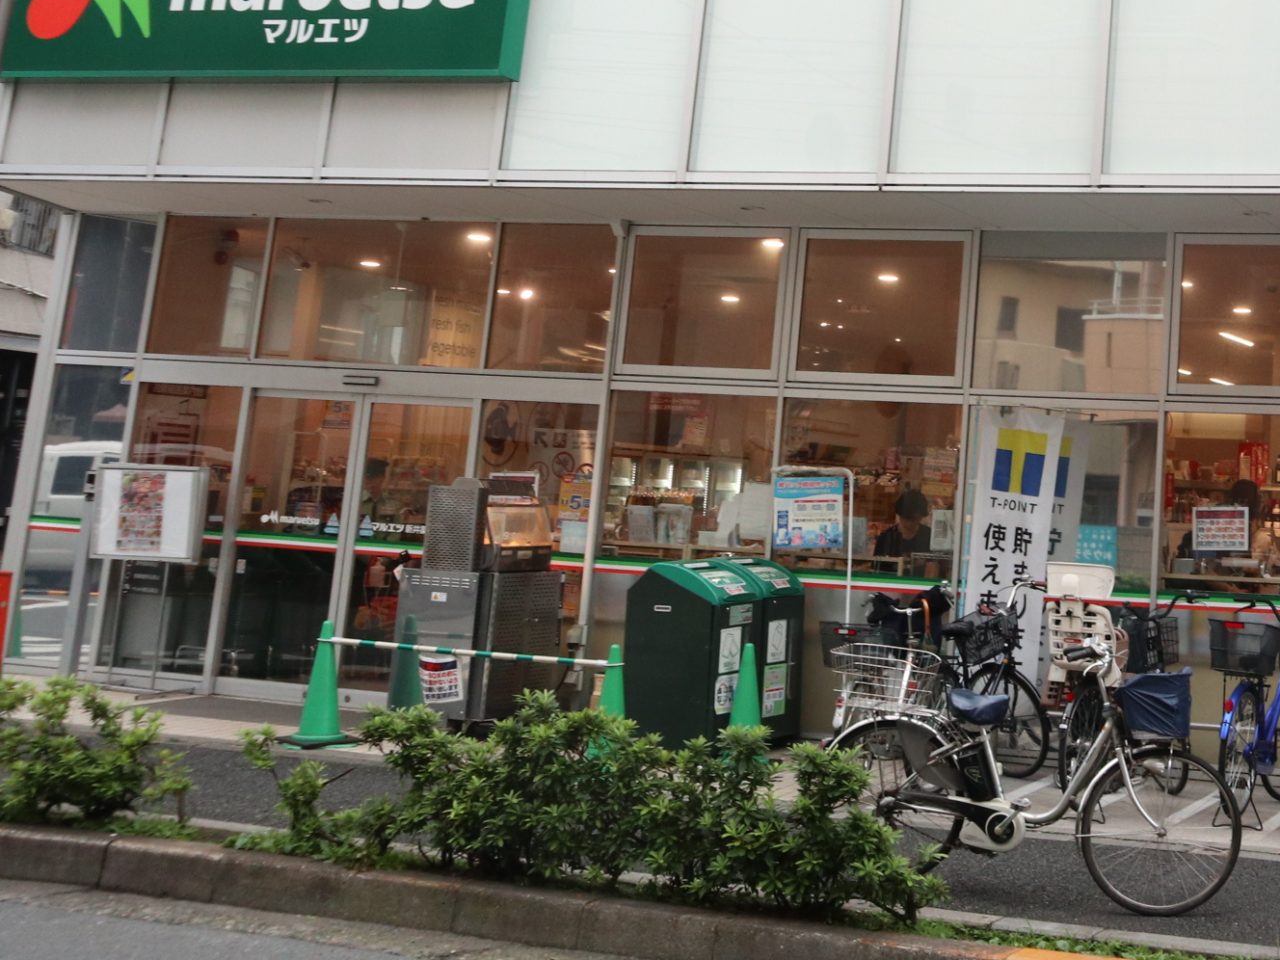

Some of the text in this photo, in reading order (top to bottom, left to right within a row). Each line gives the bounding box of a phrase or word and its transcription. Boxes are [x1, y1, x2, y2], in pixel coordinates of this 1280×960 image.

[262, 17, 370, 44] マルエツ
[989, 496, 1038, 515] T-POINT
